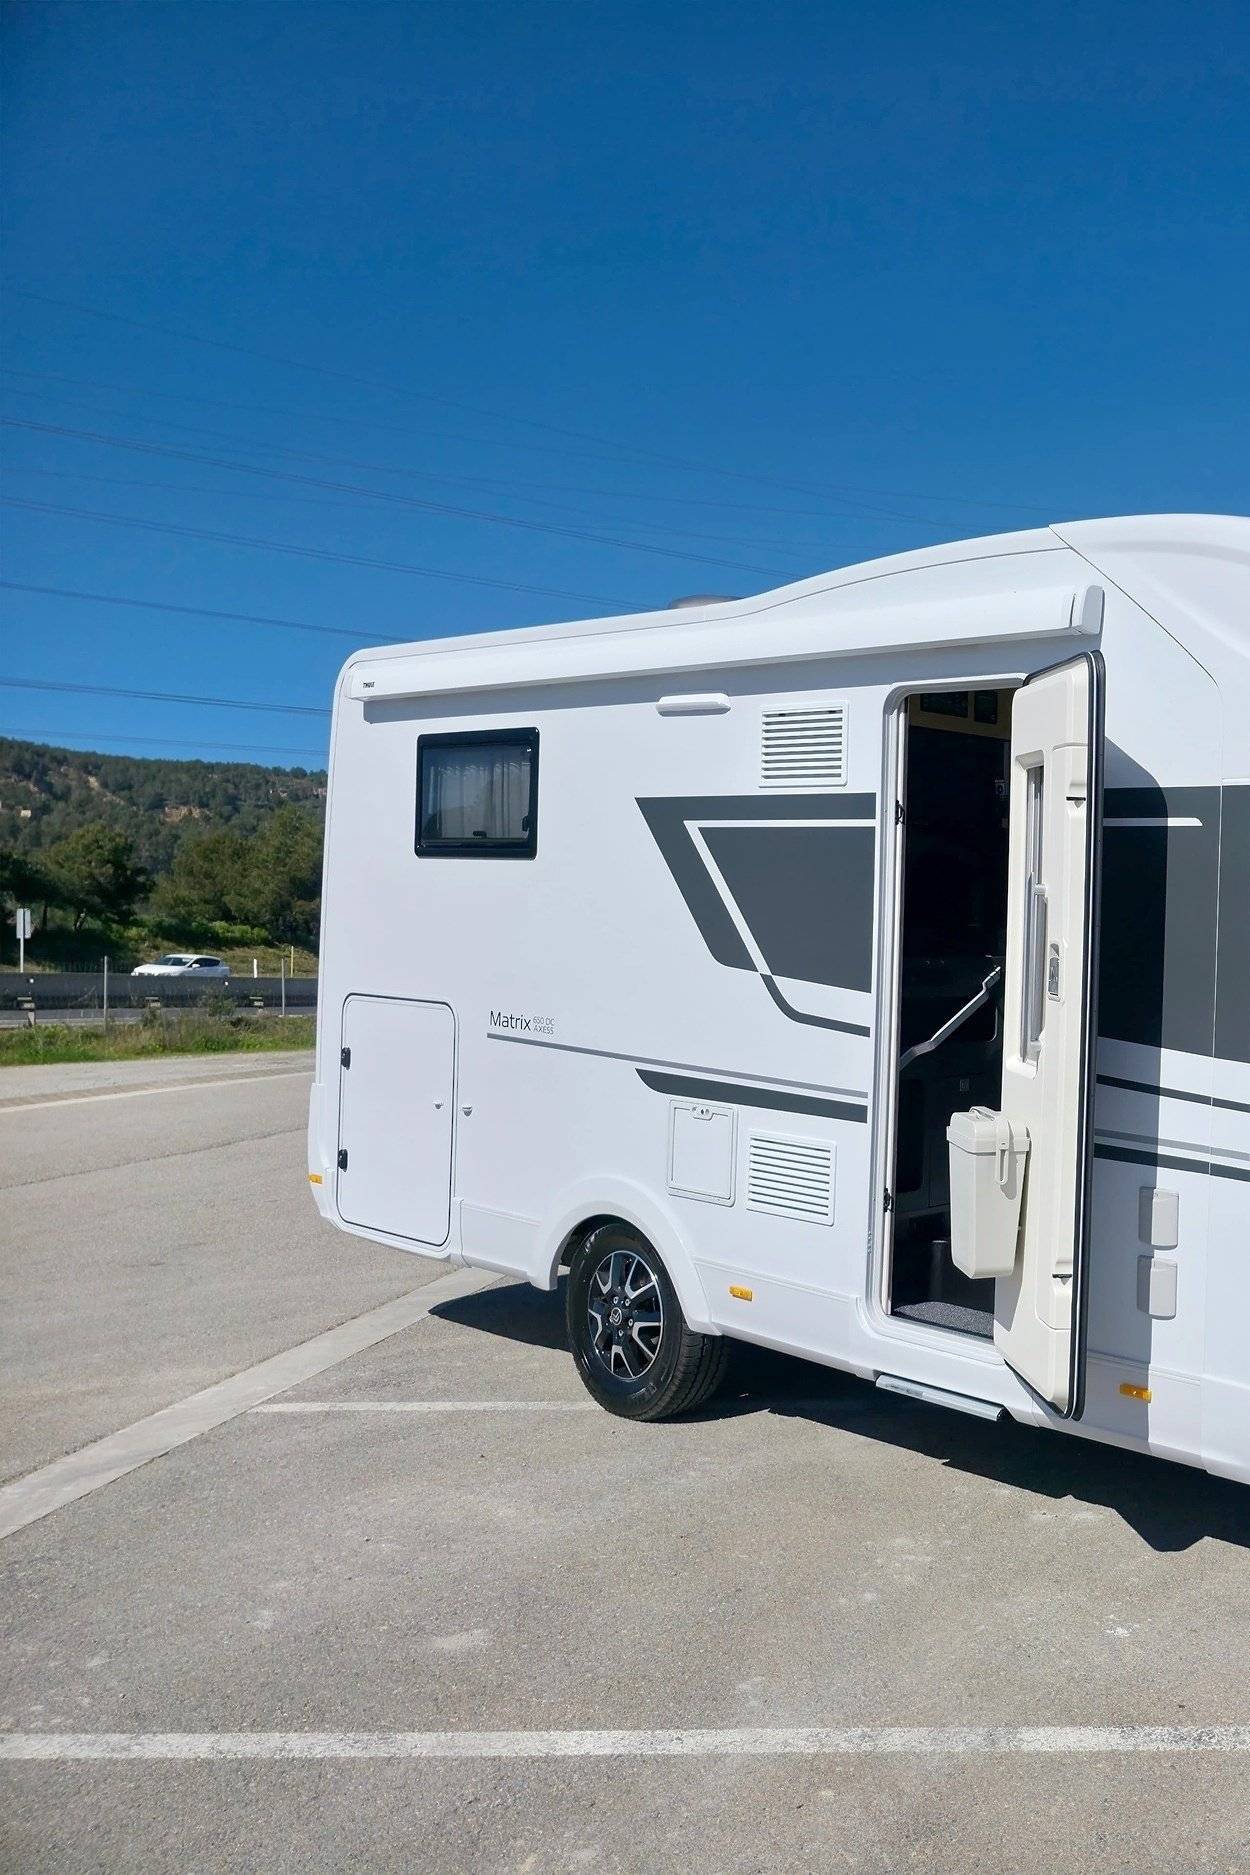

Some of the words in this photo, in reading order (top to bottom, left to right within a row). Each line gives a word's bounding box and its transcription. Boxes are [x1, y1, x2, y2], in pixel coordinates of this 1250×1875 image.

[489, 1010, 531, 1031] Matrix
[545, 1017, 555, 1027] DC
[533, 1024, 554, 1035] AXESS
